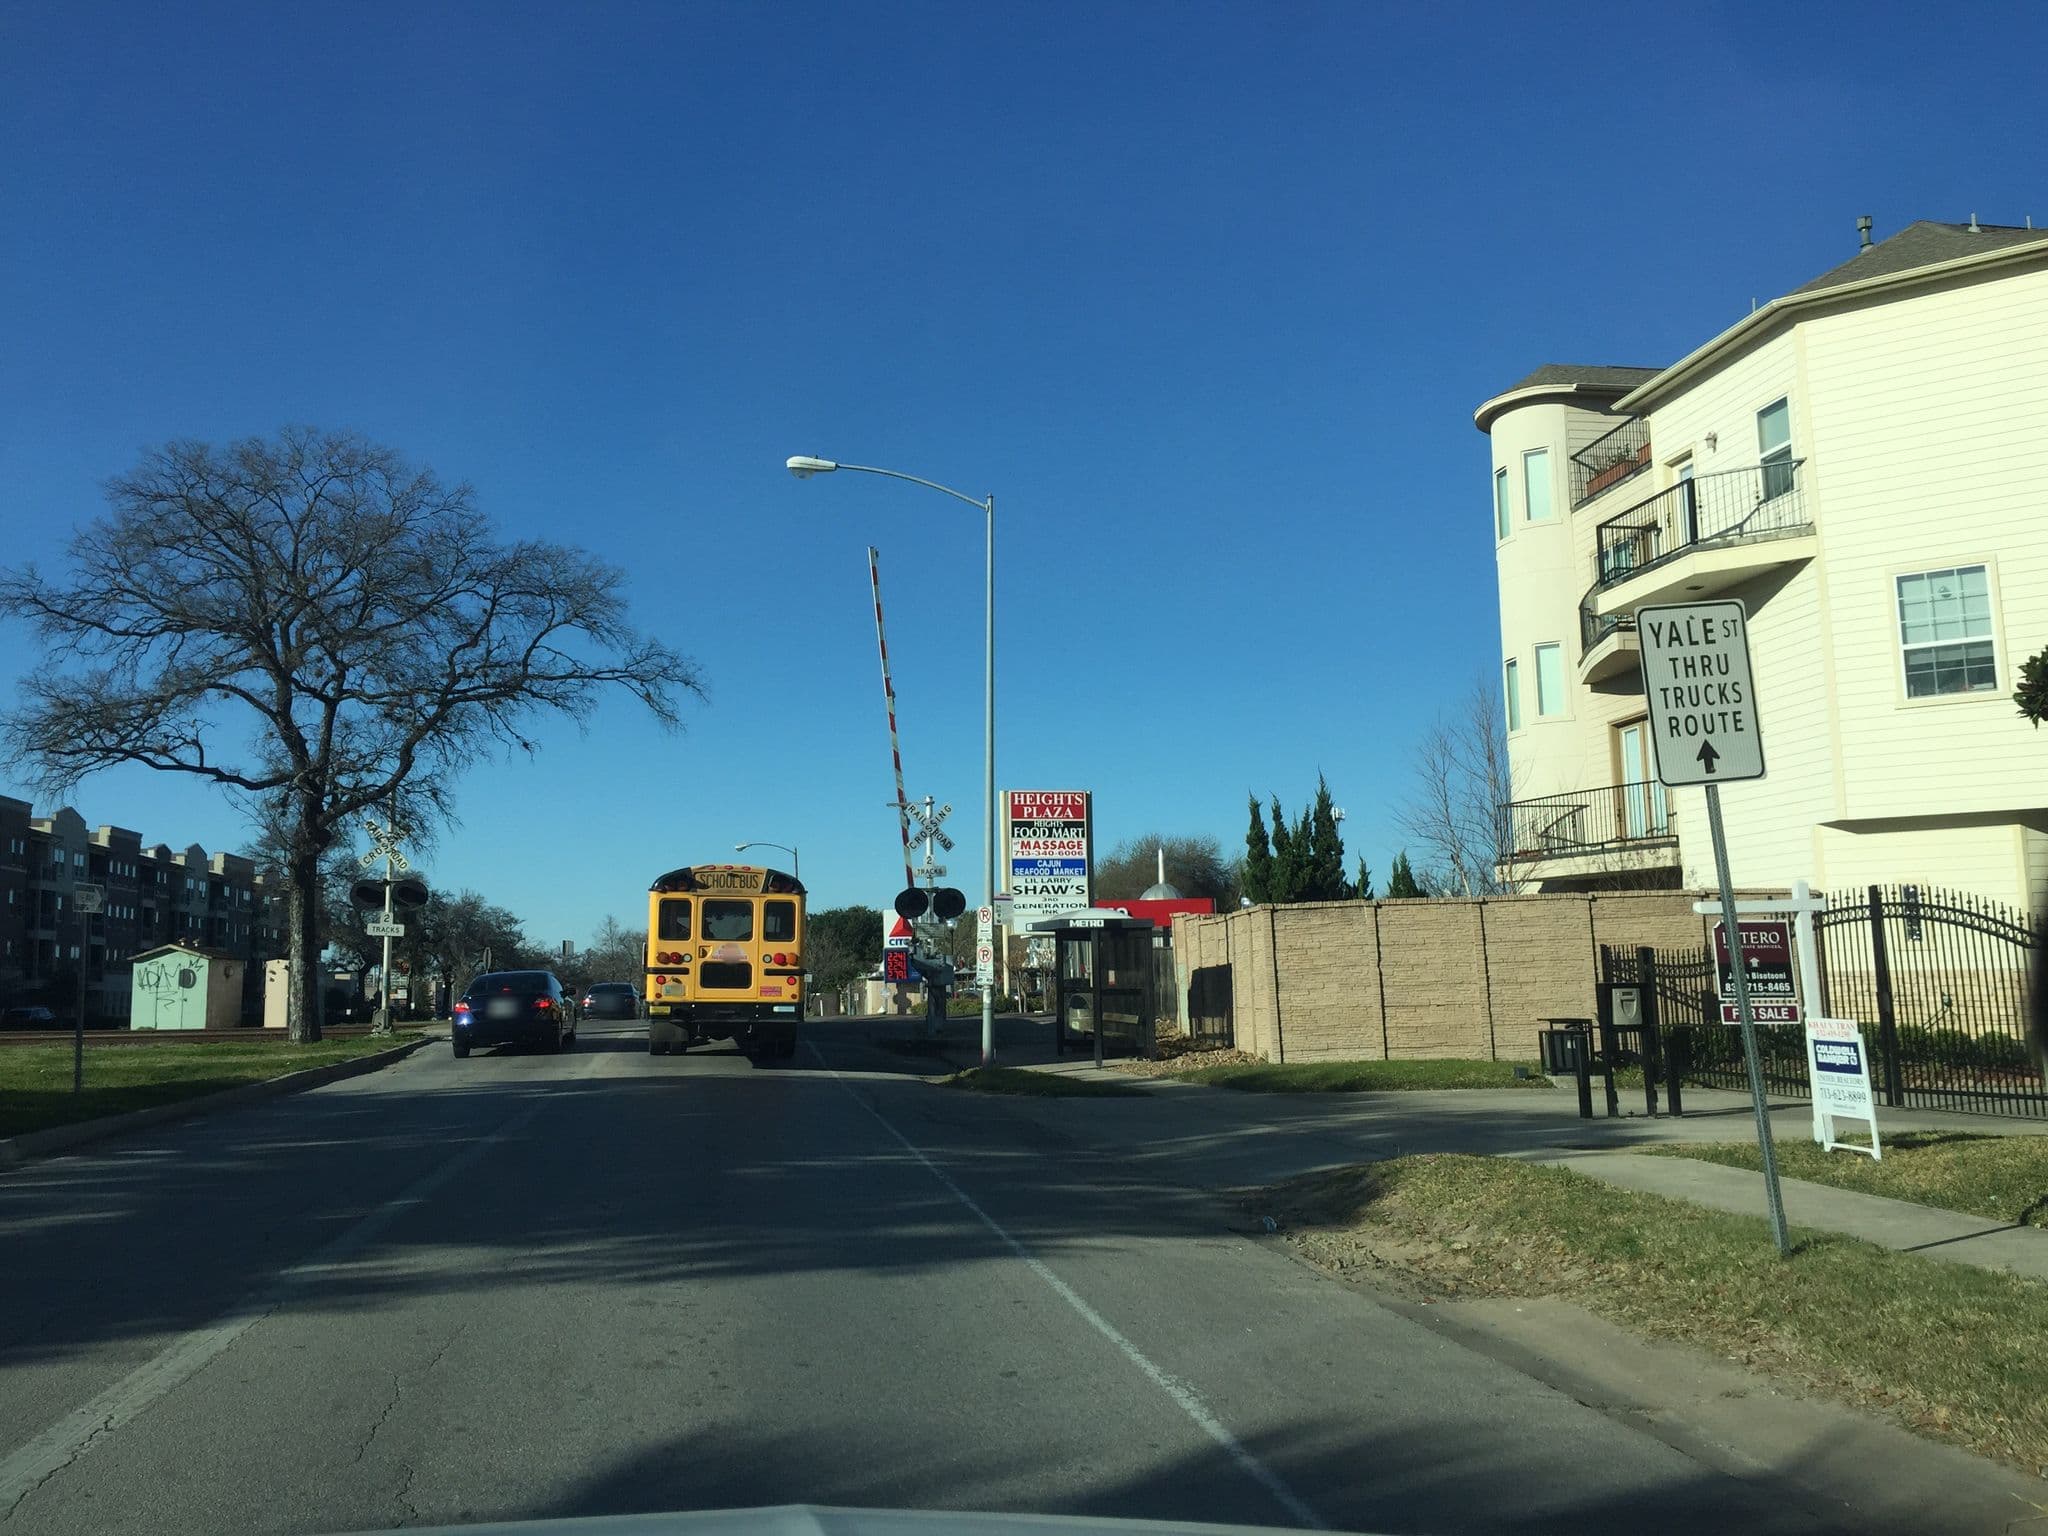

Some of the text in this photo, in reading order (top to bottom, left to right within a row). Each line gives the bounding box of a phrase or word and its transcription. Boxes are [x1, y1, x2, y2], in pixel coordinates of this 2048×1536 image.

[1648, 618, 1738, 649] YALE ST
[1668, 653, 1730, 679] THRU
[1660, 681, 1743, 710] TRUCKS
[1668, 710, 1745, 738] ROUTE
[1014, 793, 1083, 806] HEIGHTS
[1023, 806, 1073, 818] PLAZA
[1034, 820, 1064, 828] HEIGHTS
[1014, 826, 1084, 838] FOOD MART
[1020, 840, 1083, 850] MASSAGE
[926, 855, 933, 865] 2
[1037, 859, 1062, 868] CAJUN
[1014, 867, 1084, 876] SEAFOOD MARKET
[700, 873, 760, 889] SCHOOL BUS
[1012, 885, 1086, 896] SHAW'S
[383, 913, 391, 923] 2
[1069, 919, 1105, 928] METRO
[371, 926, 400, 934] TRACKS
[1722, 931, 1780, 945] ITERO
[1732, 1007, 1790, 1020] FR SALE
